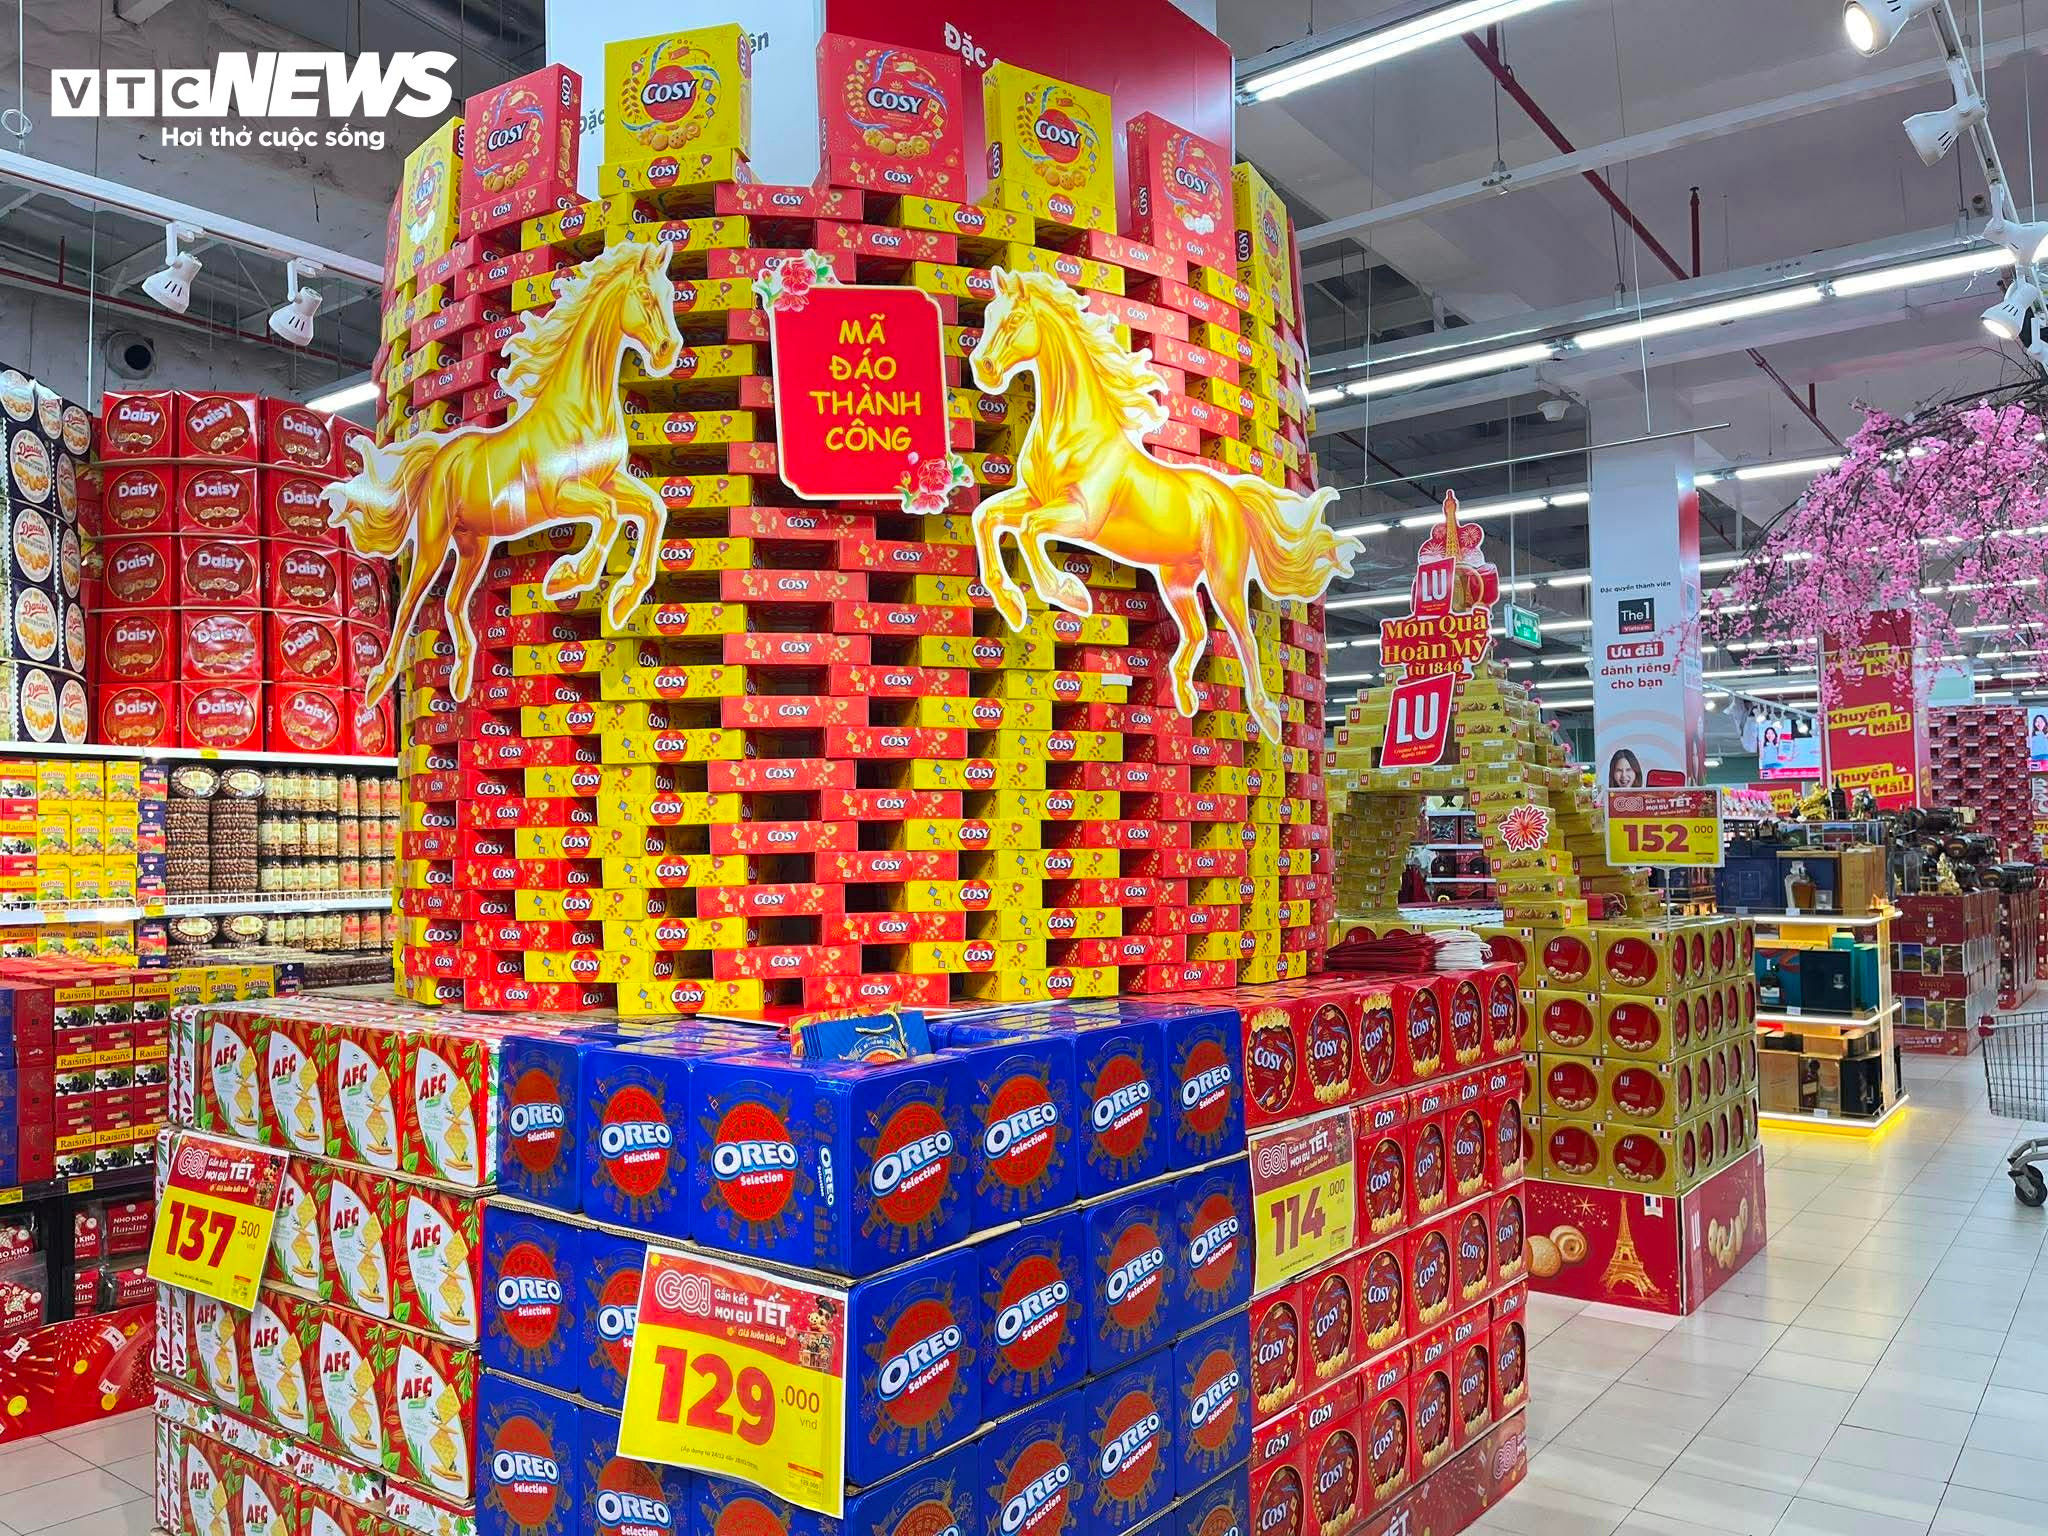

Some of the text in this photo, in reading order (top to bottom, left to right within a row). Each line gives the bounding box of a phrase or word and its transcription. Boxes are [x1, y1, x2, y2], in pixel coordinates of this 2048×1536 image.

[944, 21, 987, 68] Đặc
[560, 74, 573, 112] COSY
[641, 79, 697, 105] COSY
[867, 87, 924, 115] COSY
[487, 121, 528, 151] COSY
[1034, 118, 1082, 149] COSY
[647, 163, 681, 179] COSY
[883, 168, 915, 185] COSY
[1174, 165, 1210, 195] COSY
[953, 210, 987, 227] COSY
[1238, 229, 1250, 262] COSY
[838, 313, 886, 345] MÃ
[829, 348, 897, 381] ĐÁO
[809, 383, 921, 417] THÀNH
[119, 407, 161, 426] Daisy
[190, 403, 233, 433] Daisy
[282, 415, 323, 441] Daisy
[825, 419, 912, 452] CÔNG
[194, 481, 241, 500] Daisy
[116, 552, 156, 574] Daisy
[893, 549, 924, 562] COSY
[286, 559, 327, 579] Daisy
[351, 573, 373, 590] Daisy
[1421, 568, 1447, 602] LU
[1621, 602, 1650, 621] The 1
[1384, 617, 1435, 640] Món
[781, 641, 812, 654] COSY
[972, 645, 1004, 659] COSY
[1384, 633, 1488, 665] Hoàn Mỹ
[1611, 643, 1659, 659] Ưu đãi
[1408, 660, 1463, 676] từ 1846
[1601, 662, 1671, 676] dành riêng
[1611, 678, 1663, 691] cho bạn
[1396, 692, 1439, 744] LU
[1829, 704, 1888, 725] Khuyến
[1872, 714, 1908, 735] Mãi!
[881, 735, 911, 748] COSY
[1046, 738, 1077, 752] COSY
[1126, 769, 1150, 783] COSY
[1875, 775, 1910, 795] Mãi!
[1668, 793, 1693, 808] TẾT
[496, 806, 520, 820] COSY
[560, 835, 592, 849] COSY
[1622, 823, 1690, 853] 152
[1615, 943, 1625, 955] LU
[59, 990, 93, 1001] Raisins
[98, 987, 131, 998] Raisins
[173, 983, 202, 995] Raisins
[1551, 1005, 1561, 1017] LU
[1616, 1010, 1627, 1021] LU
[213, 1043, 238, 1068] AFC
[1254, 1047, 1284, 1072] COSY
[1314, 1038, 1338, 1060] COSY
[271, 1052, 297, 1081] AFC
[341, 1062, 368, 1091] AFC
[419, 1072, 448, 1101] AFC
[1181, 1064, 1232, 1109] OREO
[1198, 1088, 1226, 1111] Selection
[508, 1104, 565, 1135] OREO
[1374, 1108, 1396, 1128] COSY
[60, 1136, 93, 1149] Raisins
[99, 1130, 131, 1143] Raisins
[526, 1129, 556, 1144] Selection
[602, 1123, 672, 1154] OREO
[623, 1150, 661, 1165] Selection
[713, 1142, 797, 1178] OREO
[1258, 1142, 1289, 1178] GO!
[1308, 1125, 1329, 1155] TẾT
[177, 1146, 210, 1180] GO!
[229, 1155, 256, 1181] TẾT
[871, 1131, 952, 1195] OREO
[739, 1171, 785, 1188] Selection
[818, 1146, 835, 1208] OREO
[900, 1161, 942, 1193] Selection
[112, 1223, 148, 1234] Raisins
[113, 1213, 149, 1225] NHO KHÔ
[1270, 1185, 1326, 1258] 114
[79, 1233, 96, 1243] KHÔ
[166, 1200, 237, 1269] 137
[410, 1223, 442, 1252] AFC
[1691, 1212, 1701, 1251] LU
[11, 1245, 29, 1258] KHÔ
[76, 1281, 94, 1290] KHÔ
[124, 1278, 142, 1288] NHO
[655, 1269, 791, 1328] GO! Gắn kết TẾT
[4, 1314, 22, 1326] NHO
[23, 1308, 39, 1320] KHÔ
[715, 1306, 753, 1325] MỌI GU
[877, 1325, 961, 1400] OREO
[908, 1357, 950, 1395] Selection
[401, 1375, 433, 1401] AFC
[654, 1344, 777, 1446] 129
[800, 1416, 818, 1430] vnd
[300, 1462, 314, 1477] AFC
